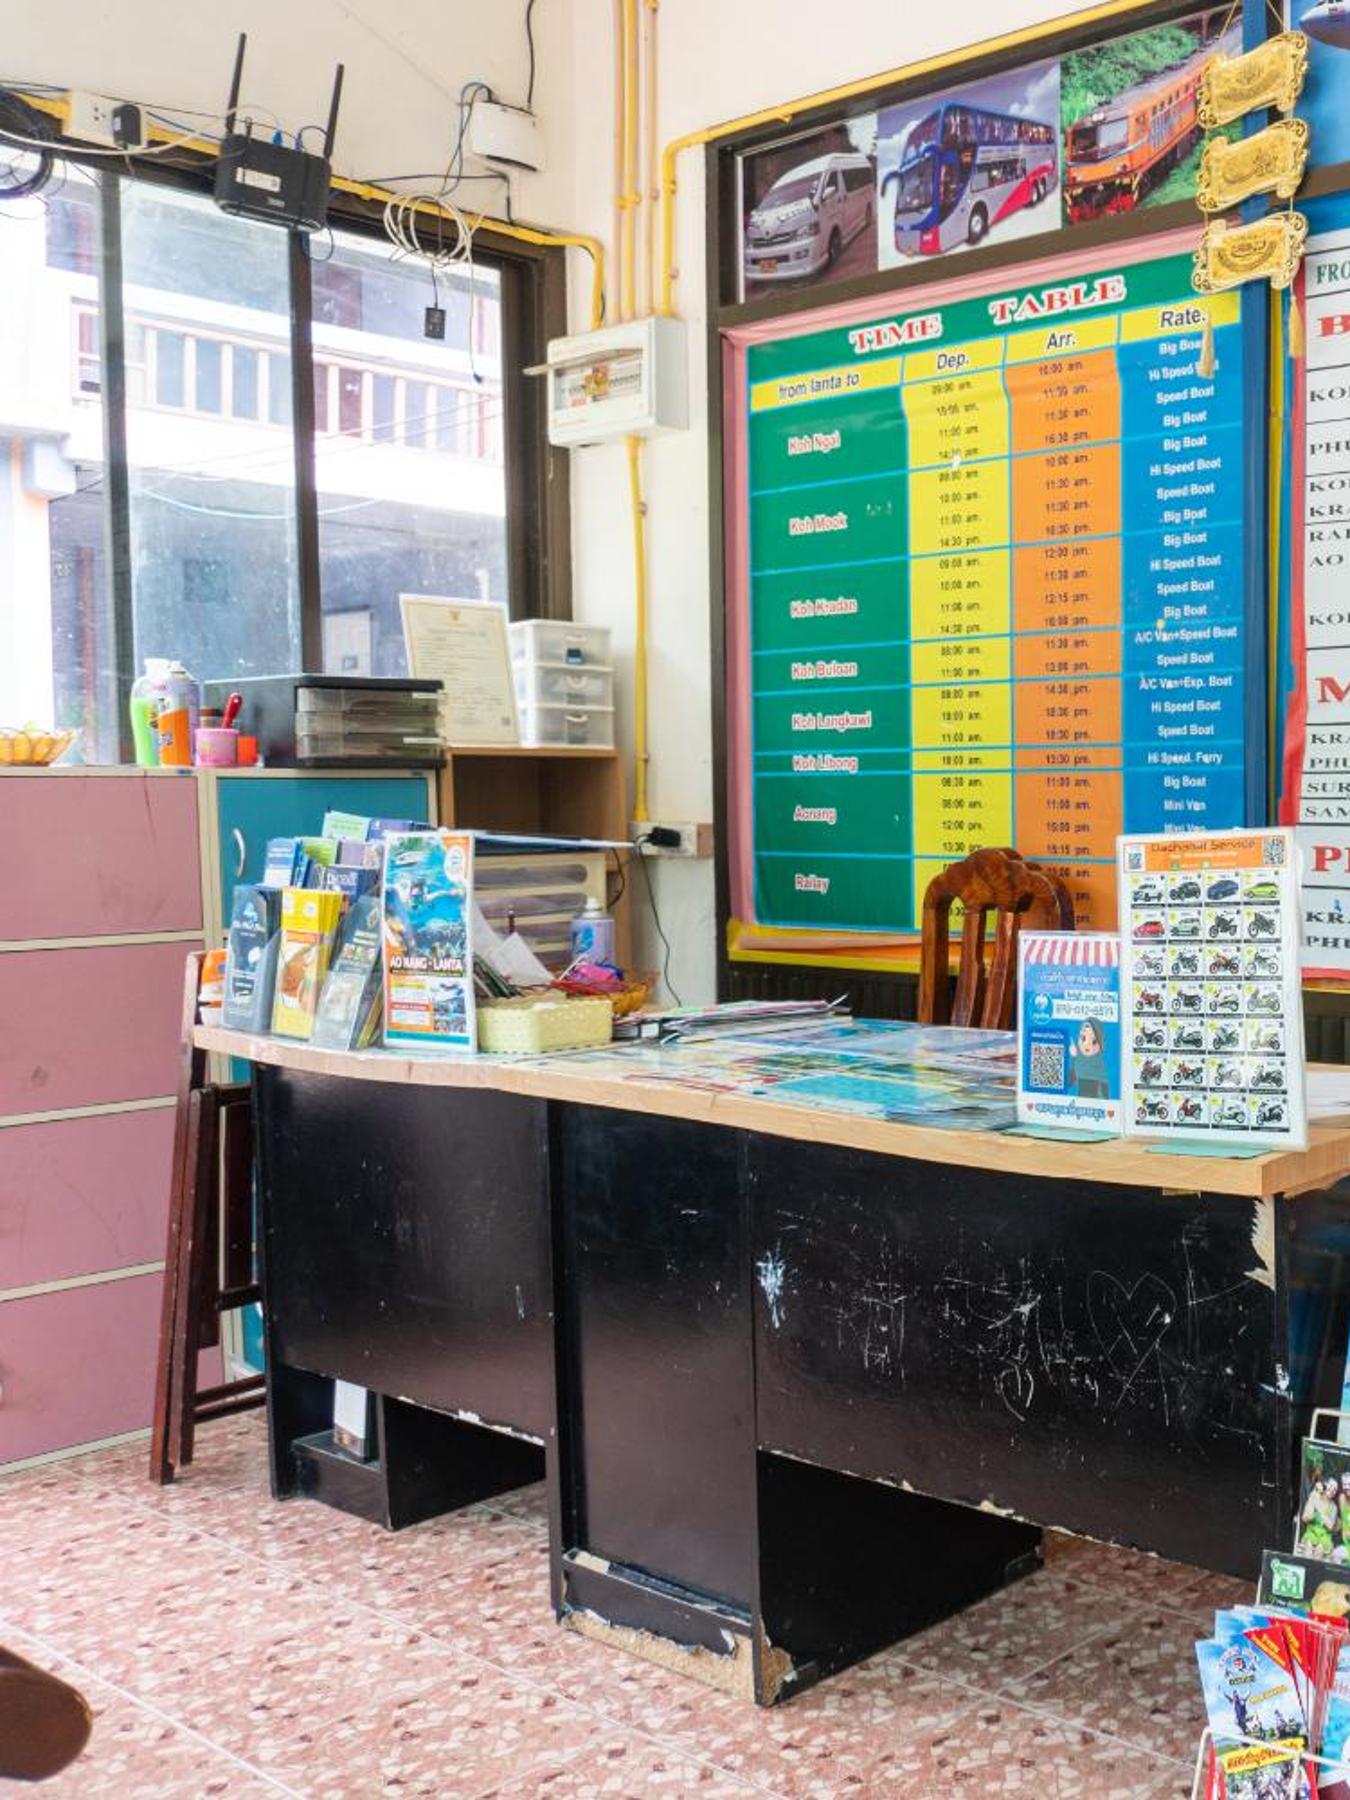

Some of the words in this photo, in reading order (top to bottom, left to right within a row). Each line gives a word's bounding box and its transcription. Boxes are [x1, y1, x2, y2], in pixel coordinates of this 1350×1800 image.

[851, 315, 941, 353] TIME
[990, 278, 1126, 324] TABLE
[1161, 309, 1206, 327] Rate.
[1045, 333, 1076, 349] Arr.
[937, 354, 969, 370] Dep.
[847, 373, 859, 386] to
[1156, 387, 1188, 404] Speed
[1190, 385, 1214, 397] Boat
[1163, 415, 1181, 427] Big
[1183, 410, 1208, 423] Boat
[1197, 457, 1221, 469] Boat
[1310, 555, 1344, 567] AO
